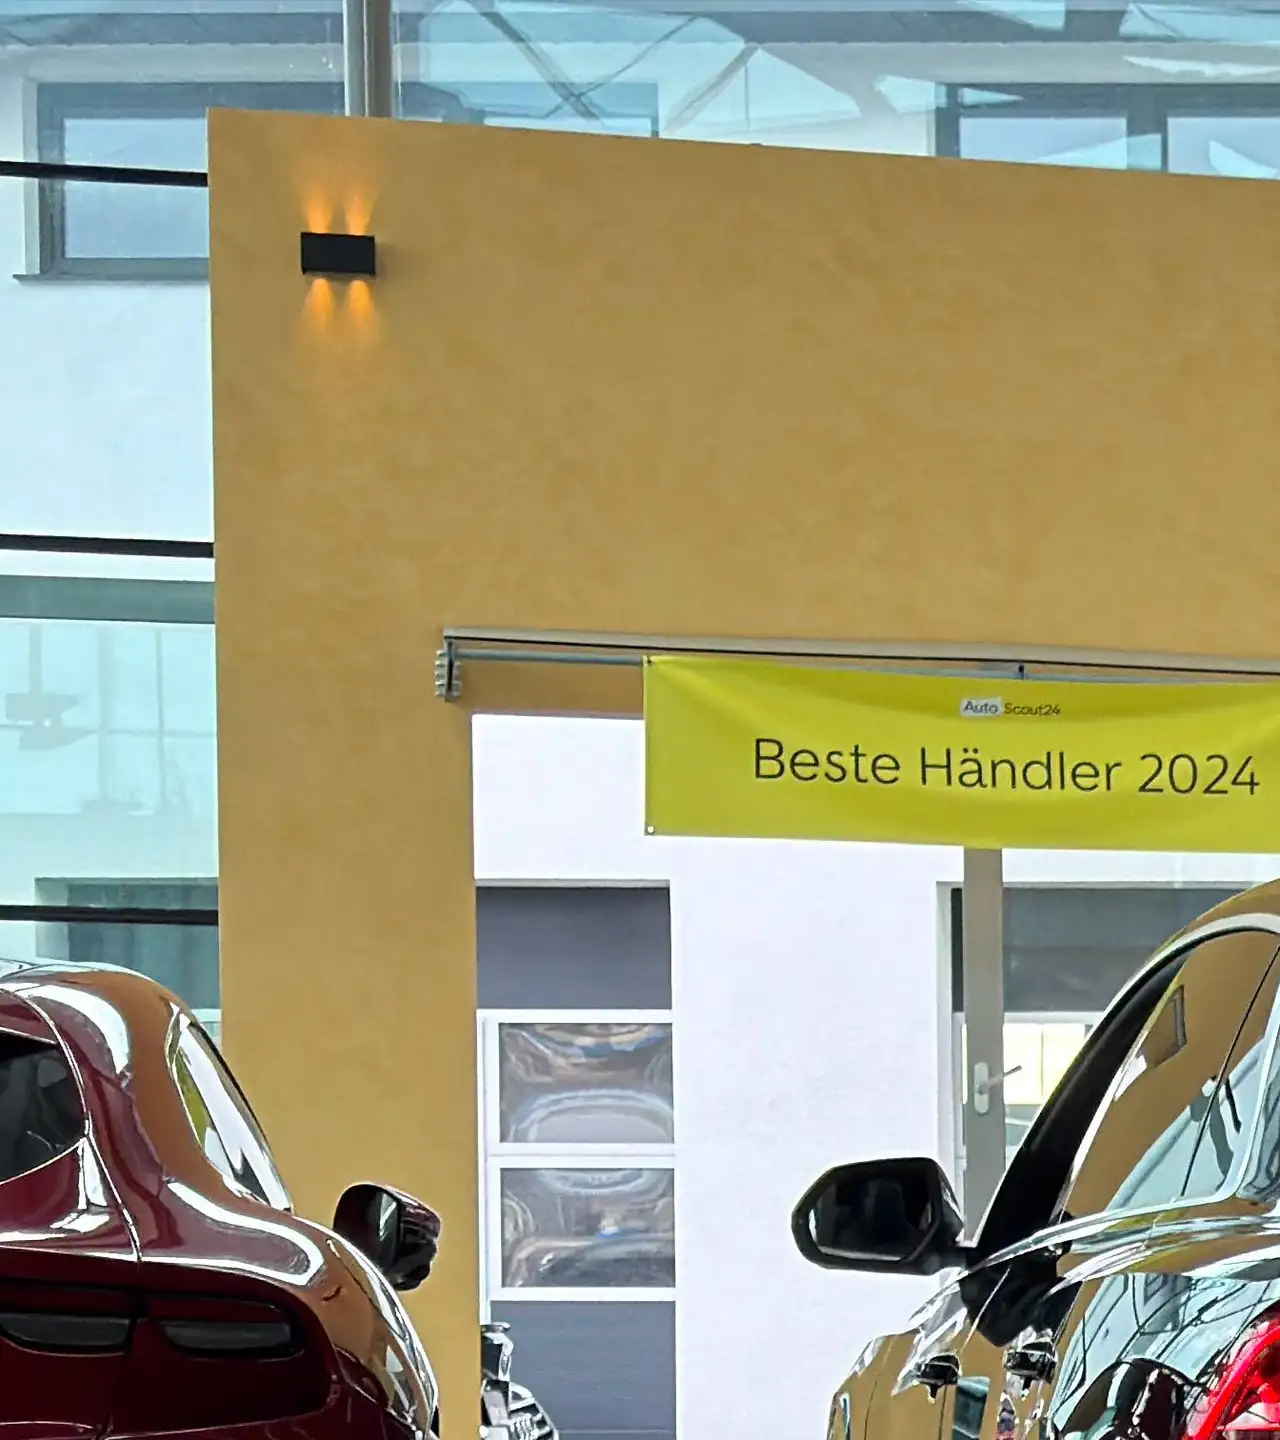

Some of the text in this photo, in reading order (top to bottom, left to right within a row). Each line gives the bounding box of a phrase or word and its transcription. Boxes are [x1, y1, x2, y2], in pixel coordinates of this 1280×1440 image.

[754, 737, 1260, 796] Beste Händler 2024
